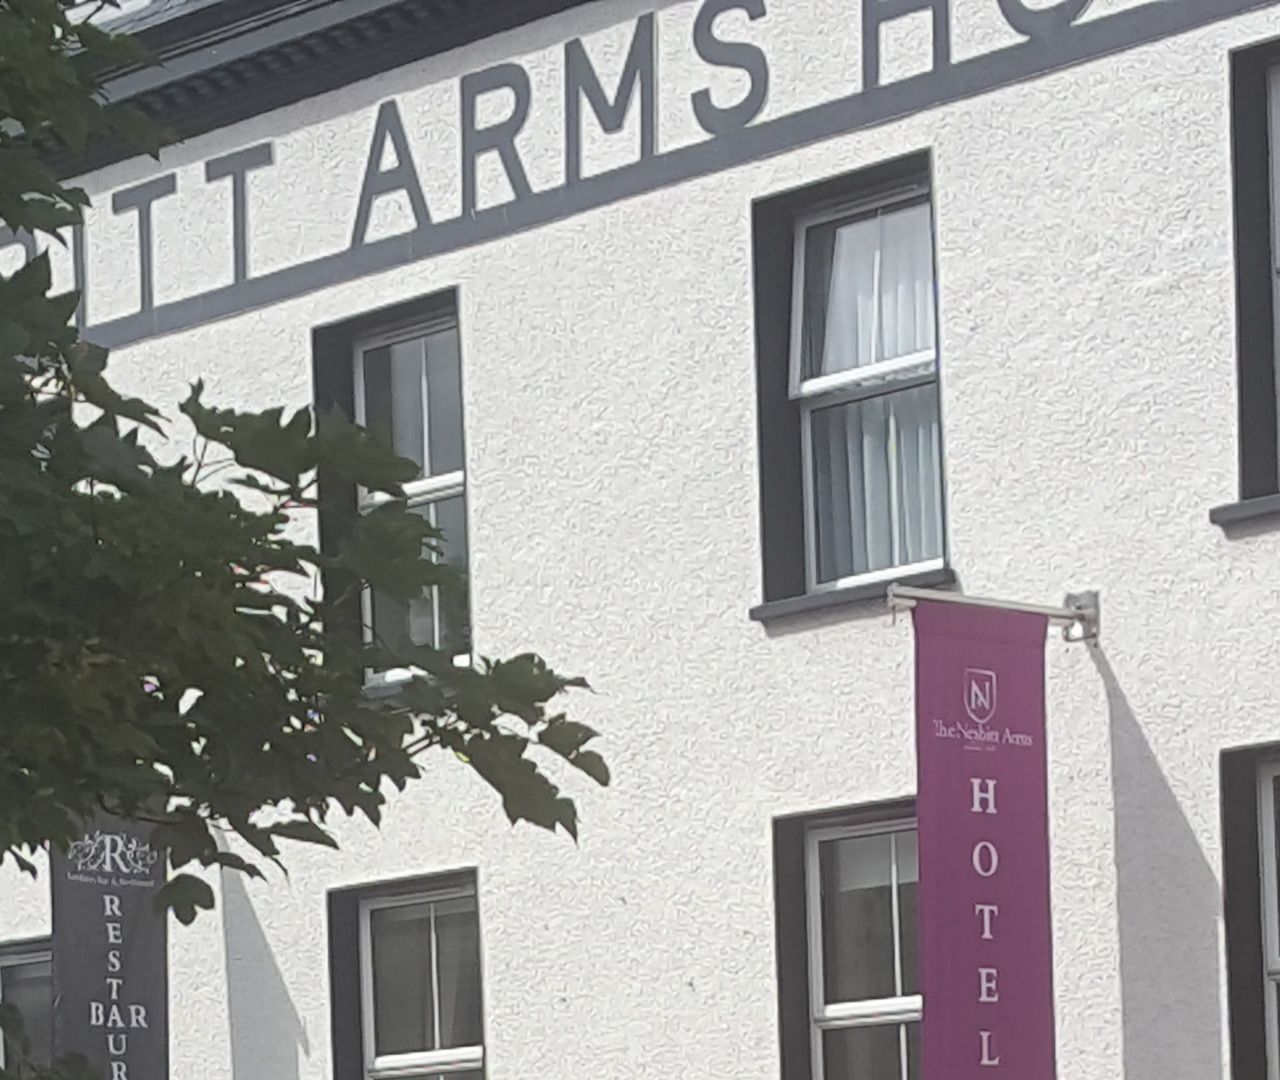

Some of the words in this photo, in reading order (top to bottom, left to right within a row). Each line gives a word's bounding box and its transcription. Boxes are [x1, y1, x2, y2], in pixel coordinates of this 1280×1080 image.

[350, 0, 770, 248] ARMS
[933, 719, 956, 739] The
[1002, 727, 1033, 747] Arms
[970, 778, 999, 1066] HOTEL
[90, 1001, 148, 1029] BAR
